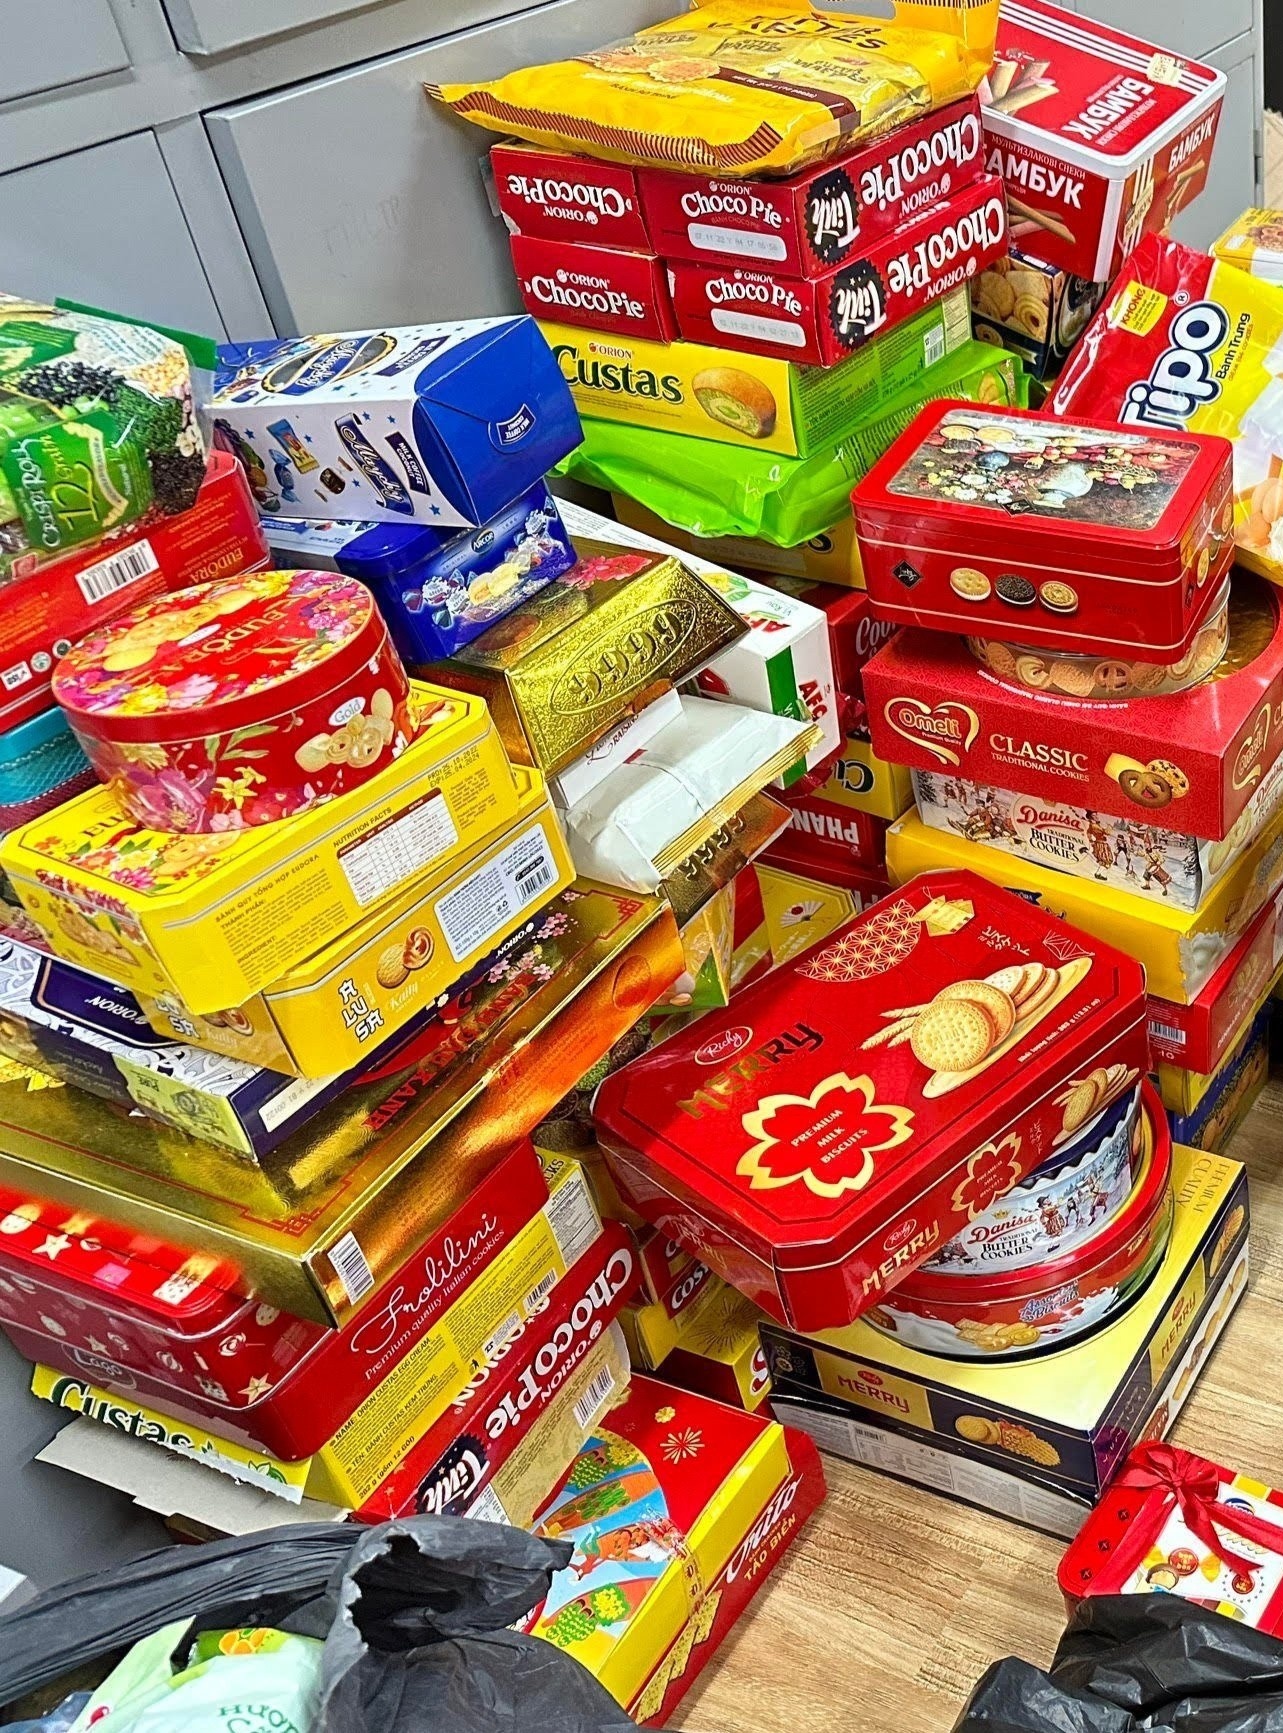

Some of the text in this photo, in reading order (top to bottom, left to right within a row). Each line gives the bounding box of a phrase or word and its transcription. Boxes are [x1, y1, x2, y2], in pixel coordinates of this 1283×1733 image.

[1062, 77, 1155, 140] БАМБУК
[1168, 115, 1215, 171] БАМБУК
[717, 182, 751, 196] ORION
[986, 148, 1084, 209] АМБУК
[544, 205, 584, 223] ORION
[901, 184, 940, 214] ORION
[569, 272, 609, 289] ORION
[744, 272, 773, 284] ORION
[924, 269, 965, 302] ORION
[598, 344, 632, 359] ORION
[550, 345, 684, 403] Custas
[409, 460, 423, 486] COFFEE
[334, 700, 361, 723] Gold
[799, 680, 827, 721] AFC
[900, 708, 961, 739] Omeli
[990, 733, 1088, 771] CLASSIC
[991, 752, 1089, 782] TRADITIONAL COOKIES
[333, 807, 392, 848] NUTRITION FACTS
[1016, 804, 1084, 831] Danisa
[1029, 838, 1079, 862] COOKIES
[1031, 828, 1075, 851] BUTTER
[1047, 828, 1085, 845] TRADITIONAL
[496, 926, 527, 957] ORION
[86, 996, 134, 1025] ORION
[702, 1029, 743, 1058] Richy
[676, 1023, 824, 1119] MERRY
[791, 1109, 843, 1147] PREMIUM
[817, 1126, 845, 1148] MILK
[821, 1128, 868, 1164] BISCUITS
[967, 1213, 1037, 1245] Danisa
[983, 1237, 1029, 1252] BUTTER
[999, 1228, 1037, 1242] TRADITIONAL
[862, 1220, 939, 1296] MERRY
[981, 1244, 1033, 1261] COOKIES
[365, 1229, 505, 1381] Premium quality Italian cookies
[1162, 1291, 1196, 1358] MERRY
[357, 1395, 376, 1417] ORION
[376, 1372, 398, 1398] CUSTAS
[398, 1359, 411, 1374] EGG
[410, 1337, 431, 1361] CREAM
[541, 1340, 591, 1403] ORION
[838, 1375, 909, 1413] MERRY
[50, 1375, 195, 1450] Custas
[382, 1409, 404, 1435] CUSTAS
